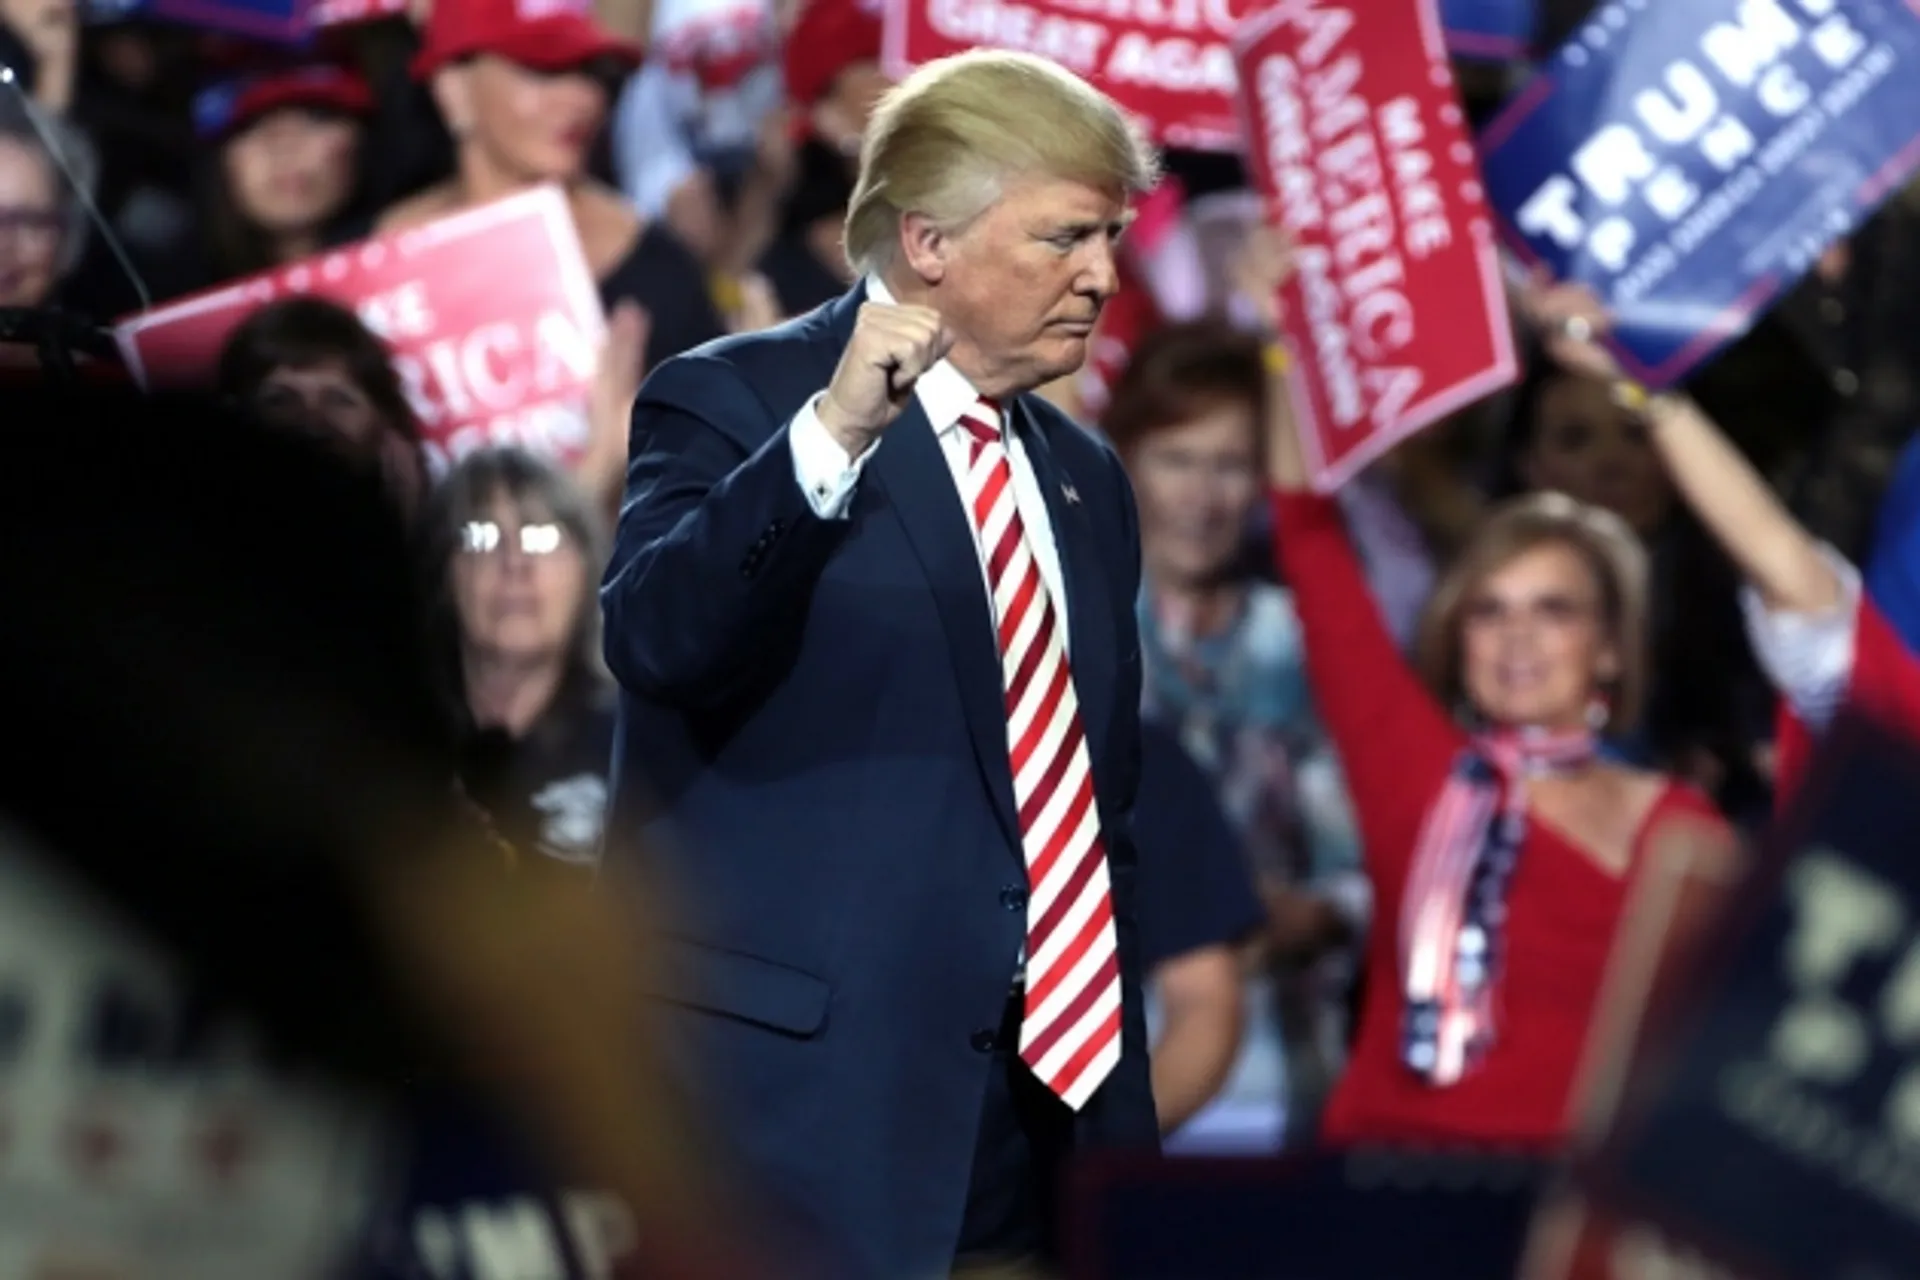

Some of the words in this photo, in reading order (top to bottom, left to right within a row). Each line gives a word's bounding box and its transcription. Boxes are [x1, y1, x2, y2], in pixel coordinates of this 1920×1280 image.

[1105, 32, 1238, 90] AGA
[1588, 12, 1868, 273] PENCE
[1288, 3, 1424, 427] AMERICA
[1376, 96, 1452, 260] MAKE
